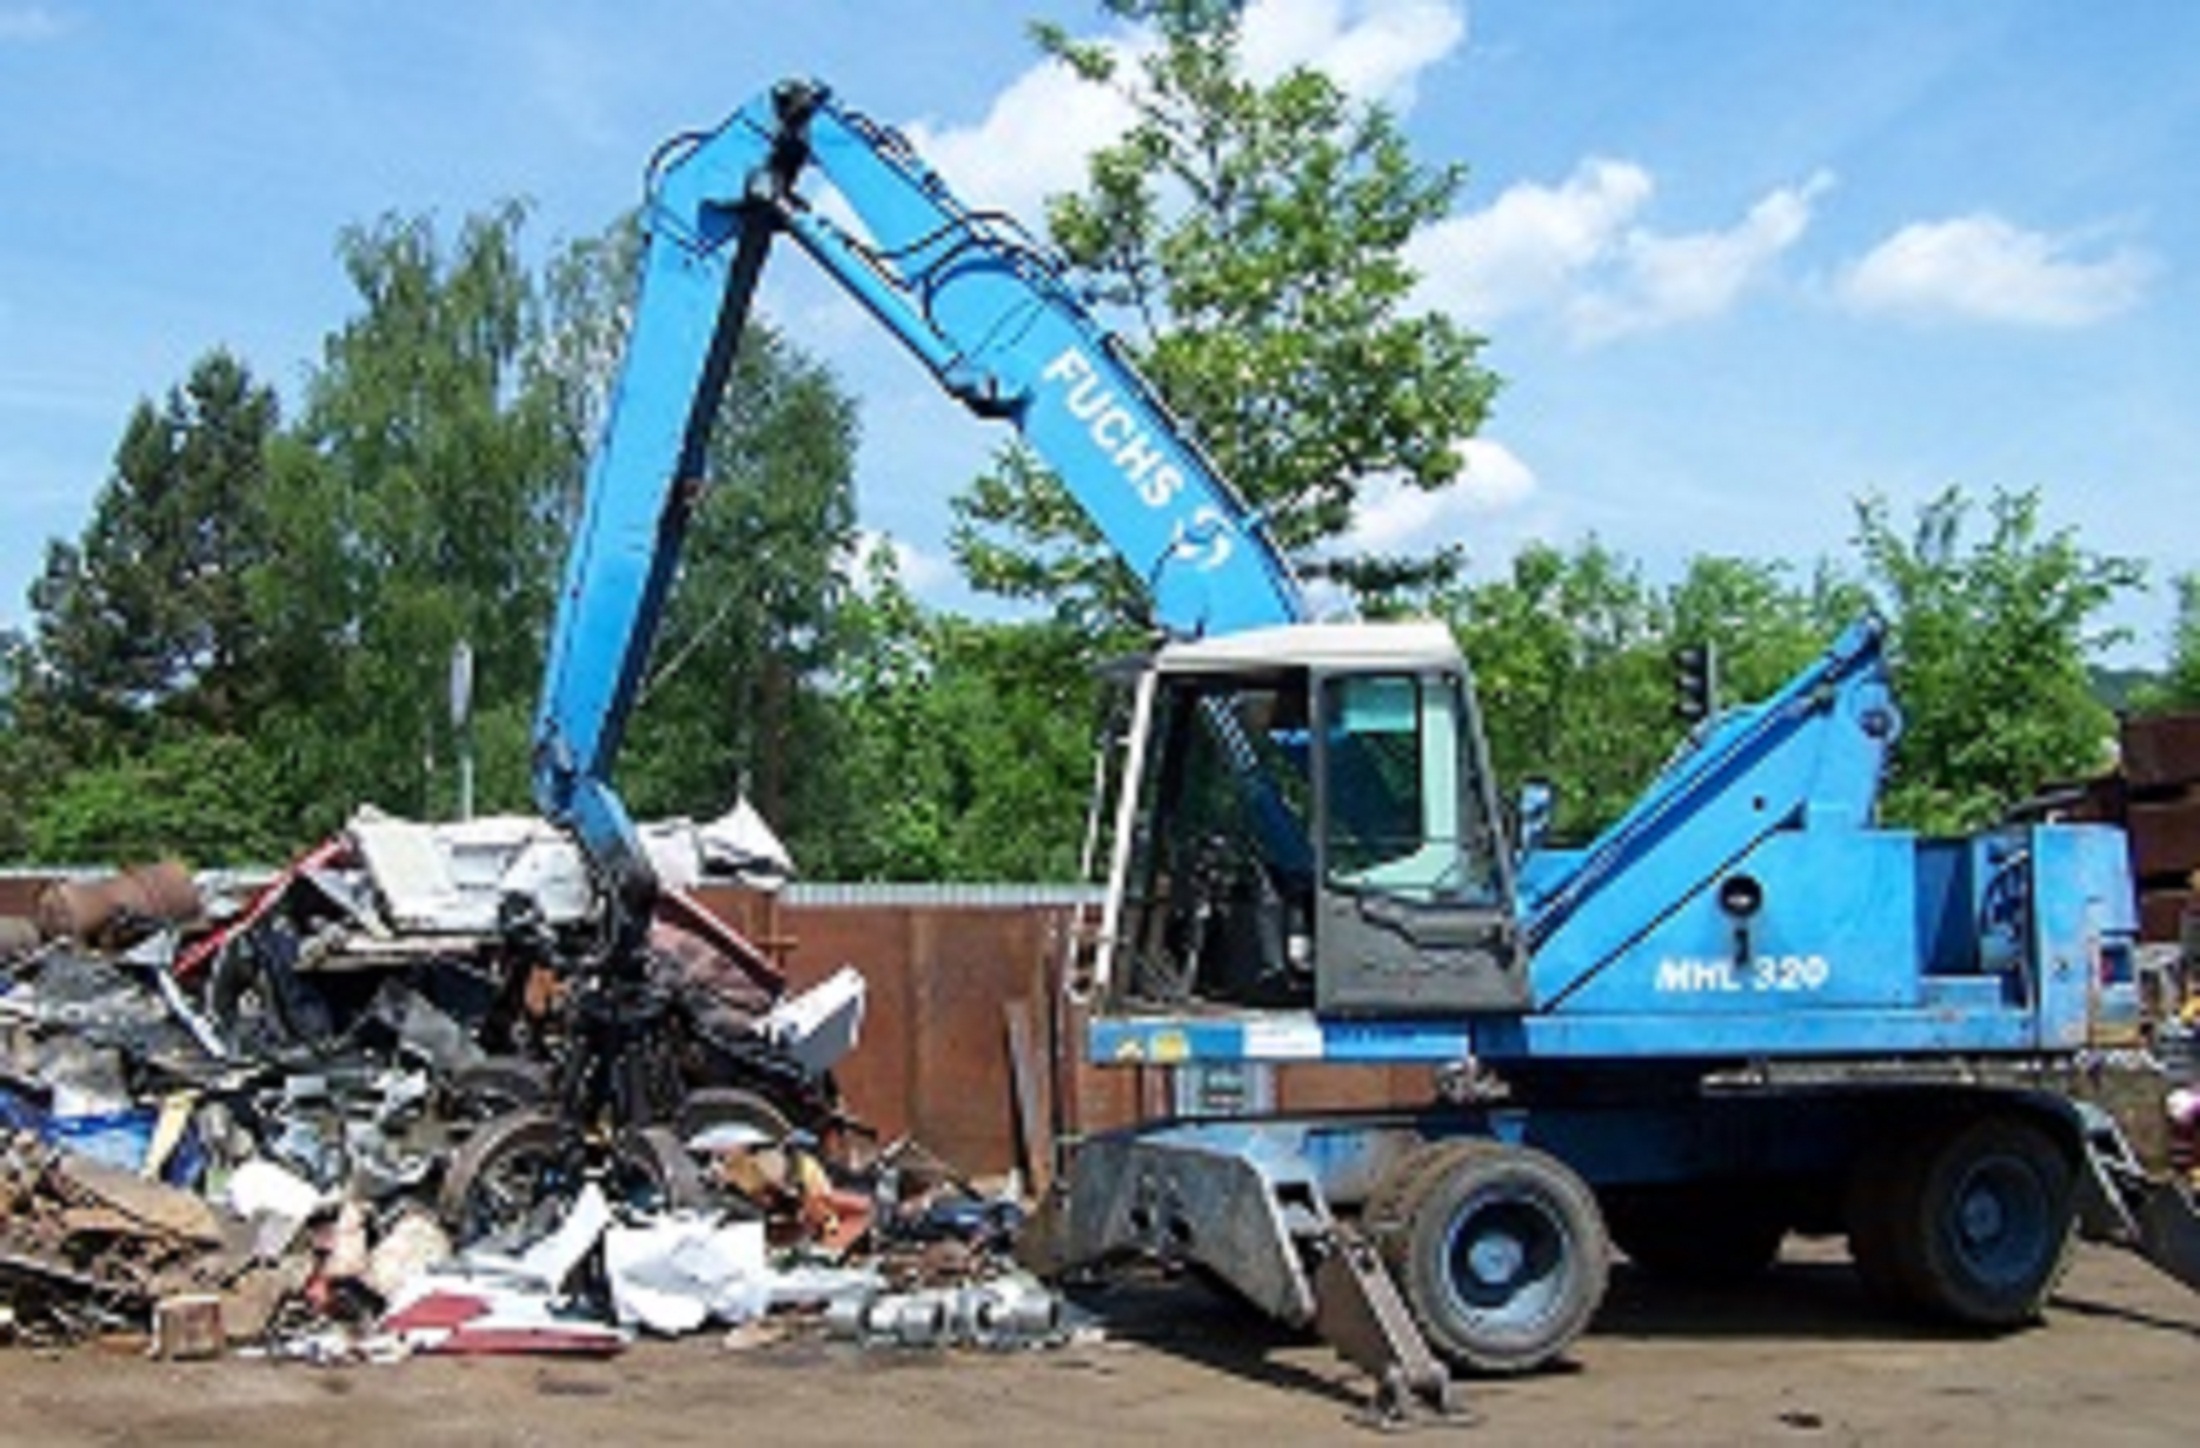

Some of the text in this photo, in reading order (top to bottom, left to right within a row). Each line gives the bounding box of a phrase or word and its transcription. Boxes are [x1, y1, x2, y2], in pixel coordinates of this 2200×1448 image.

[1041, 346, 1184, 507] FUCHS
[1654, 954, 1830, 992] MHL 320
